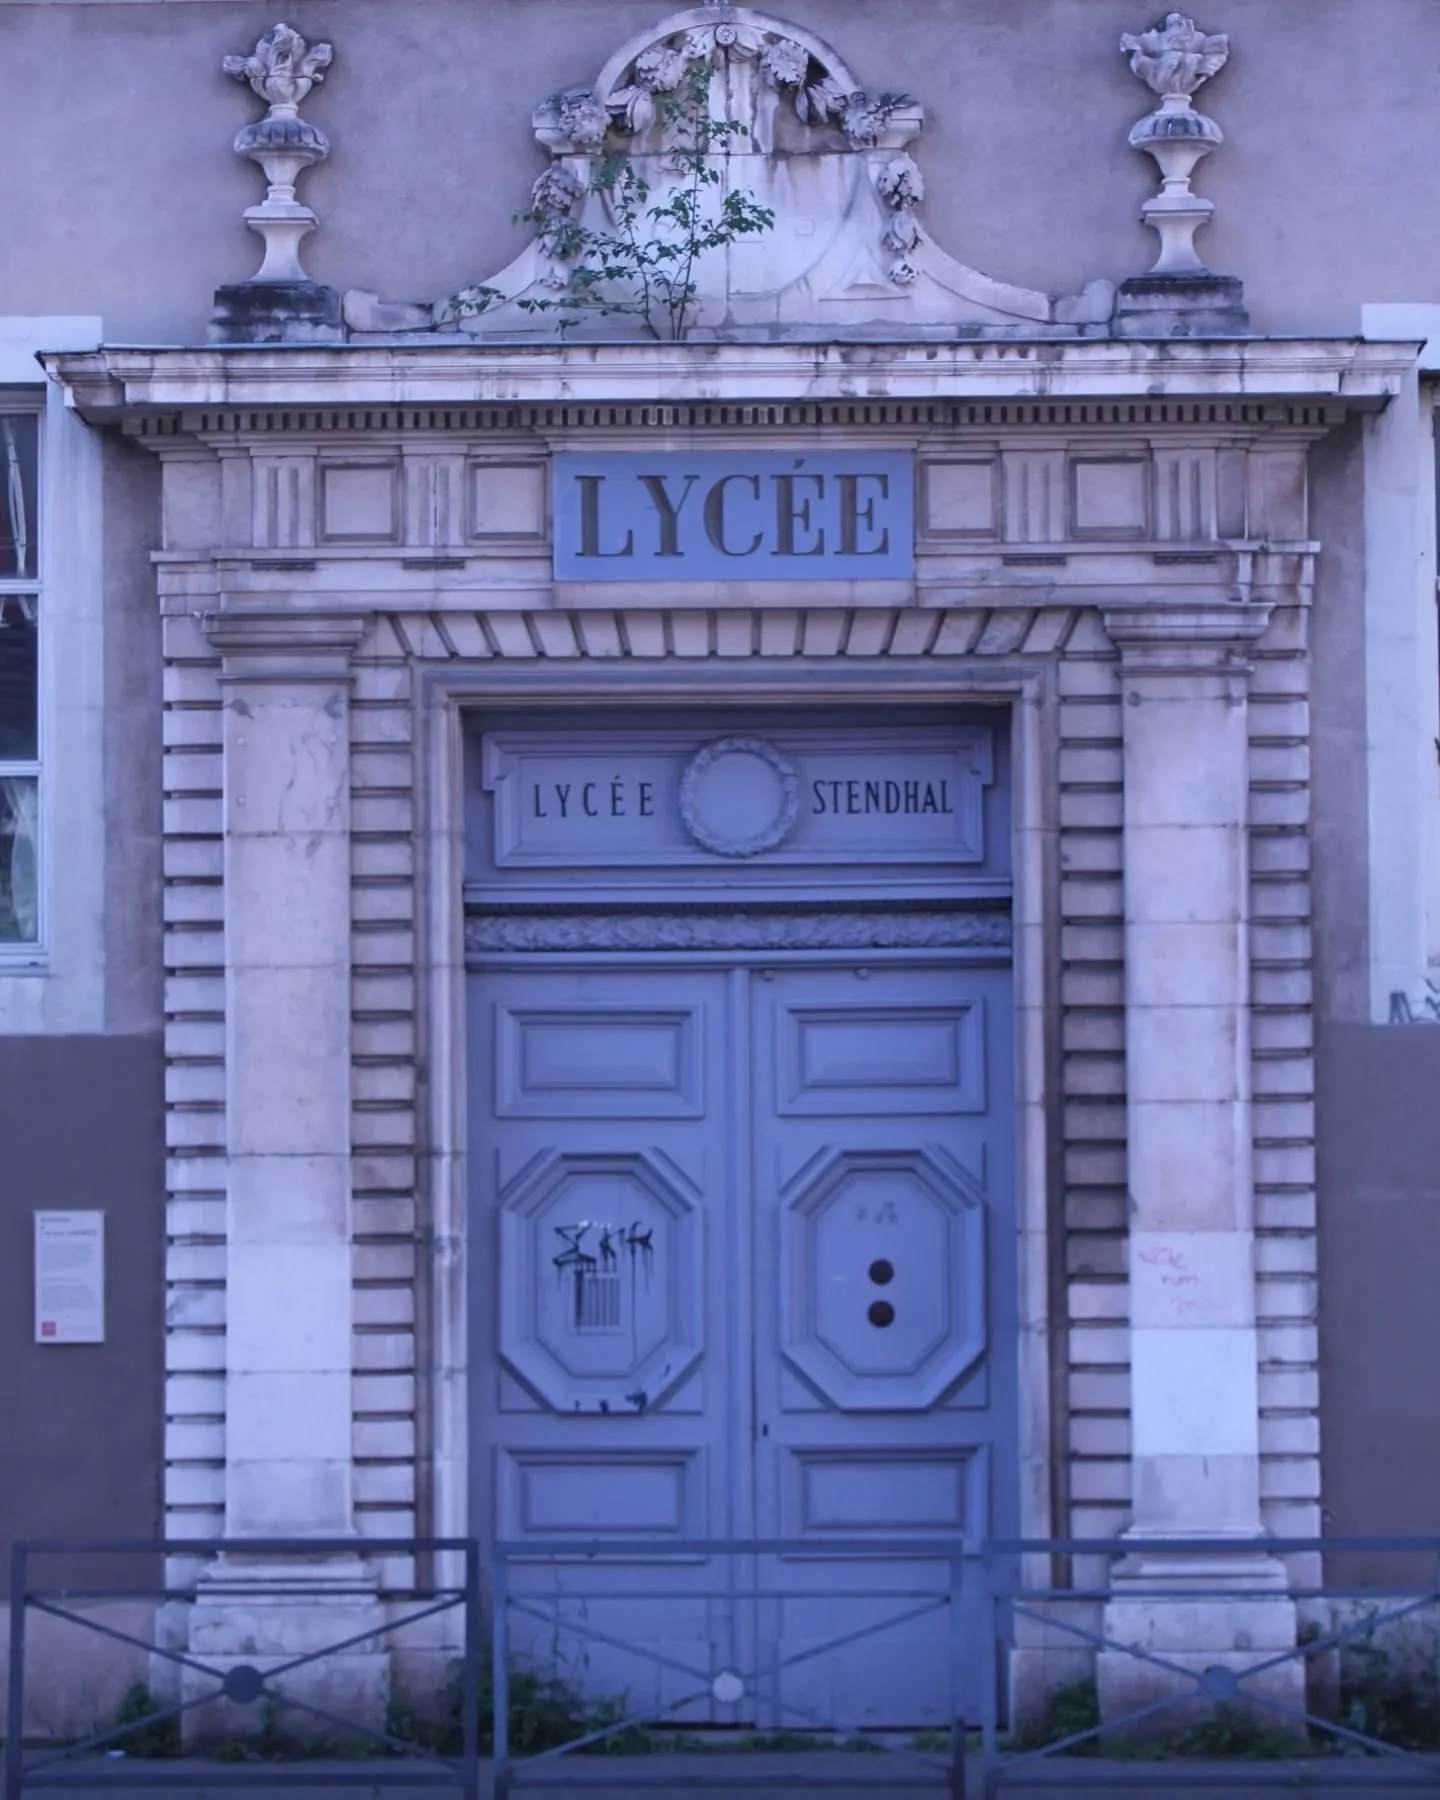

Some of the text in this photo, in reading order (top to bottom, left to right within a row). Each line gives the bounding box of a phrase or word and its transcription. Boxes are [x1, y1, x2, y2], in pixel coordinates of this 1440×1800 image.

[574, 458, 889, 557] LYCÉE
[533, 775, 954, 818] LYCÉE STENDHAL
